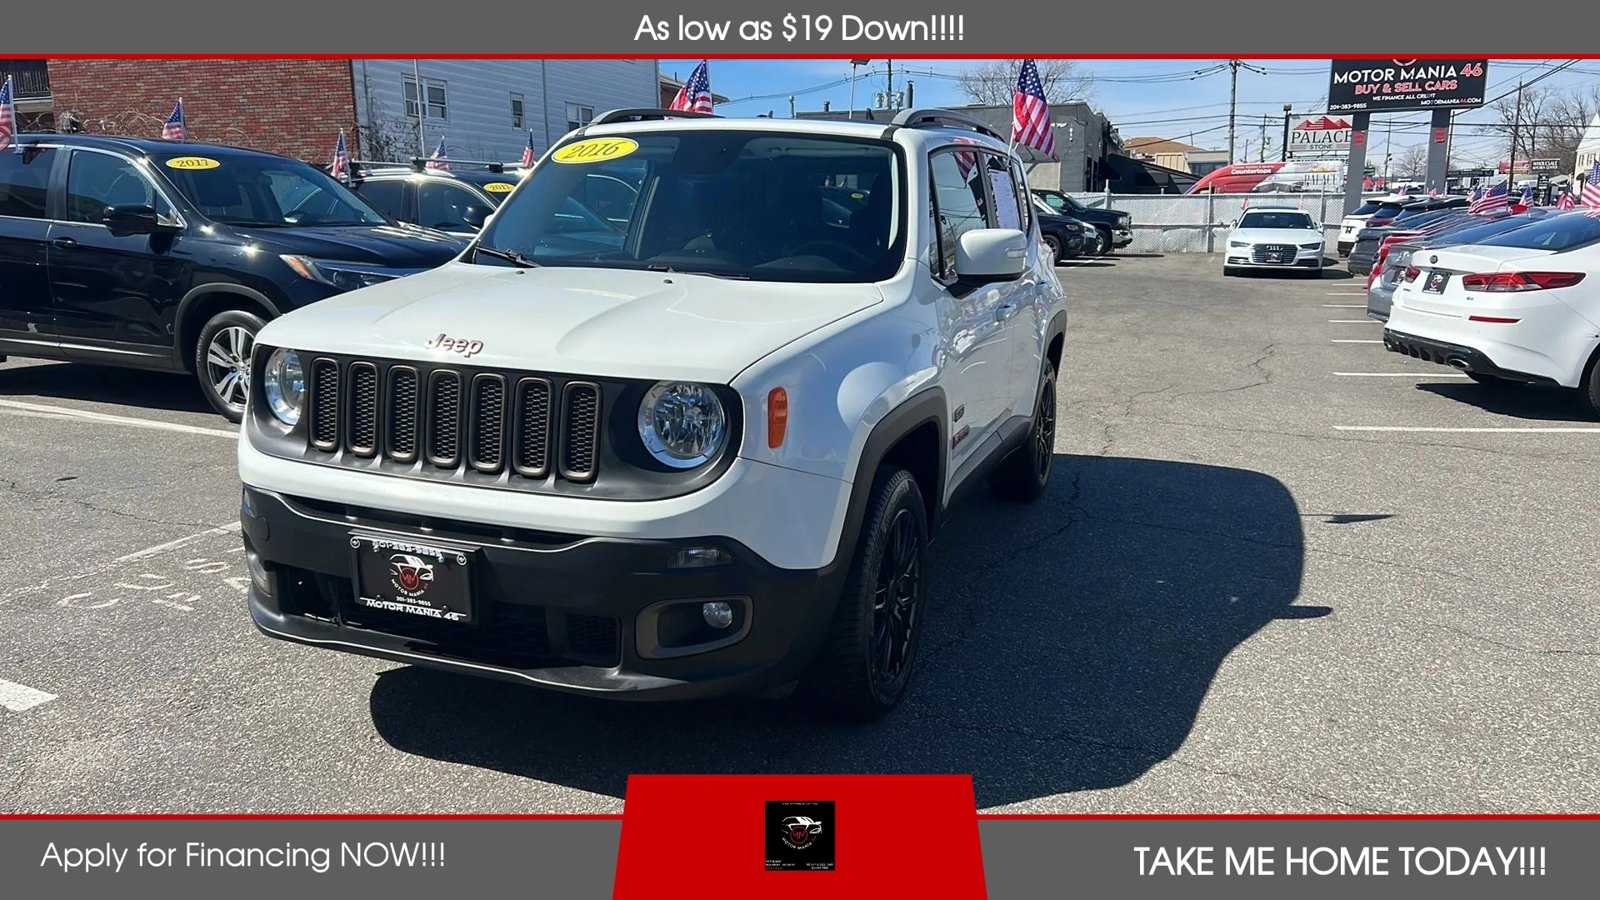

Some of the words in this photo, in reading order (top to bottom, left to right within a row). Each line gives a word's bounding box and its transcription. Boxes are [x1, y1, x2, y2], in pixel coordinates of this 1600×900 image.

[1333, 67, 1395, 84] MOTOR
[1400, 65, 1457, 80] MANIA
[1460, 62, 1483, 77] 46
[1354, 83, 1379, 95] BUY
[1382, 83, 1392, 94] &
[1394, 81, 1422, 93] SELL
[1424, 79, 1458, 91] CARS
[561, 141, 628, 159] 2016
[176, 159, 208, 167] 2017
[1304, 174, 1337, 186] PALACE
[424, 333, 484, 358] Jeep
[391, 578, 408, 596] MOTOR
[408, 589, 425, 597] MANIA
[366, 599, 405, 612] MOTOR
[405, 605, 442, 619] MANIA
[443, 612, 460, 621] 46
